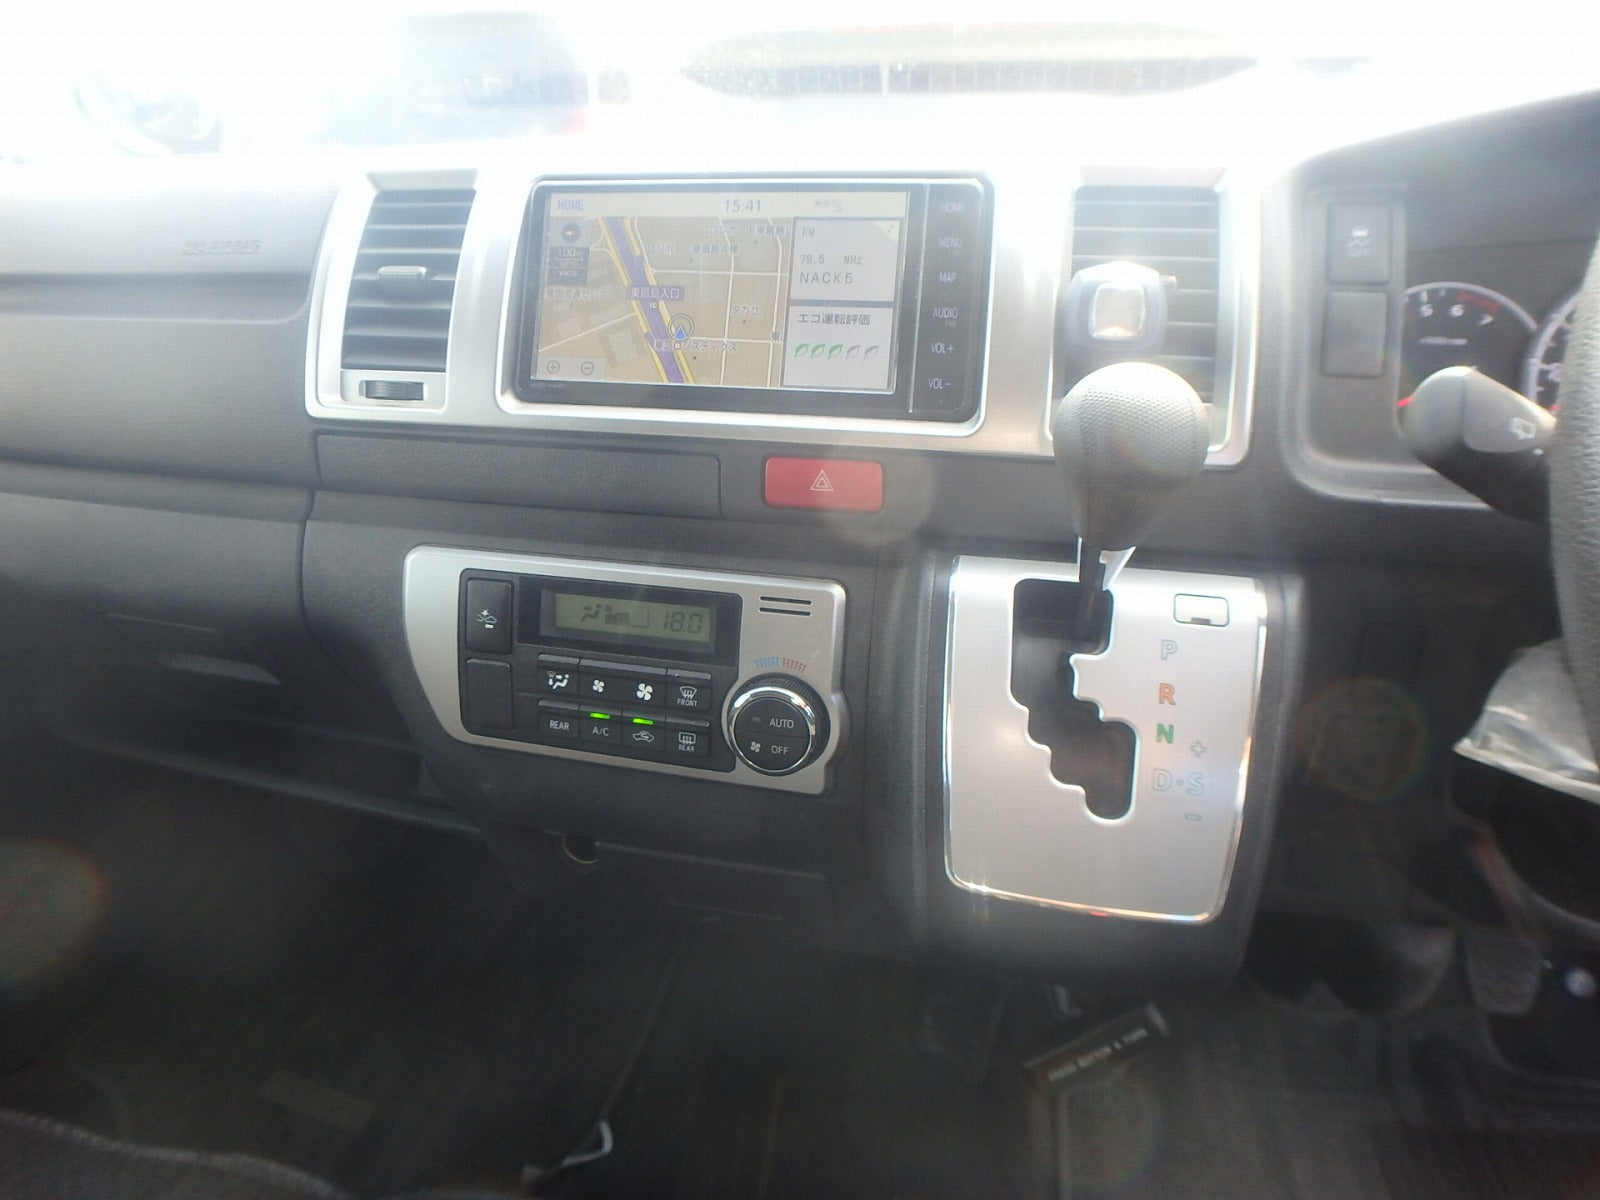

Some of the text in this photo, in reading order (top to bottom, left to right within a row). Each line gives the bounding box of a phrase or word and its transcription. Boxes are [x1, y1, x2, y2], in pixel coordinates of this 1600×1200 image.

[557, 199, 584, 211] HOME
[724, 199, 762, 213] 15:41
[939, 237, 963, 249] MENU
[800, 254, 825, 265] 79.5
[799, 271, 854, 285] NACK5
[939, 272, 957, 283] MAP
[932, 307, 959, 319] AUDIO
[1161, 639, 1178, 661] P
[1158, 682, 1176, 705] R
[677, 698, 698, 707] FRONT
[550, 719, 570, 731] REAR
[769, 717, 795, 729] AUTO
[592, 726, 609, 737] A/C
[1156, 723, 1175, 744] N
[678, 744, 695, 753] REAR
[771, 745, 789, 755] OFF
